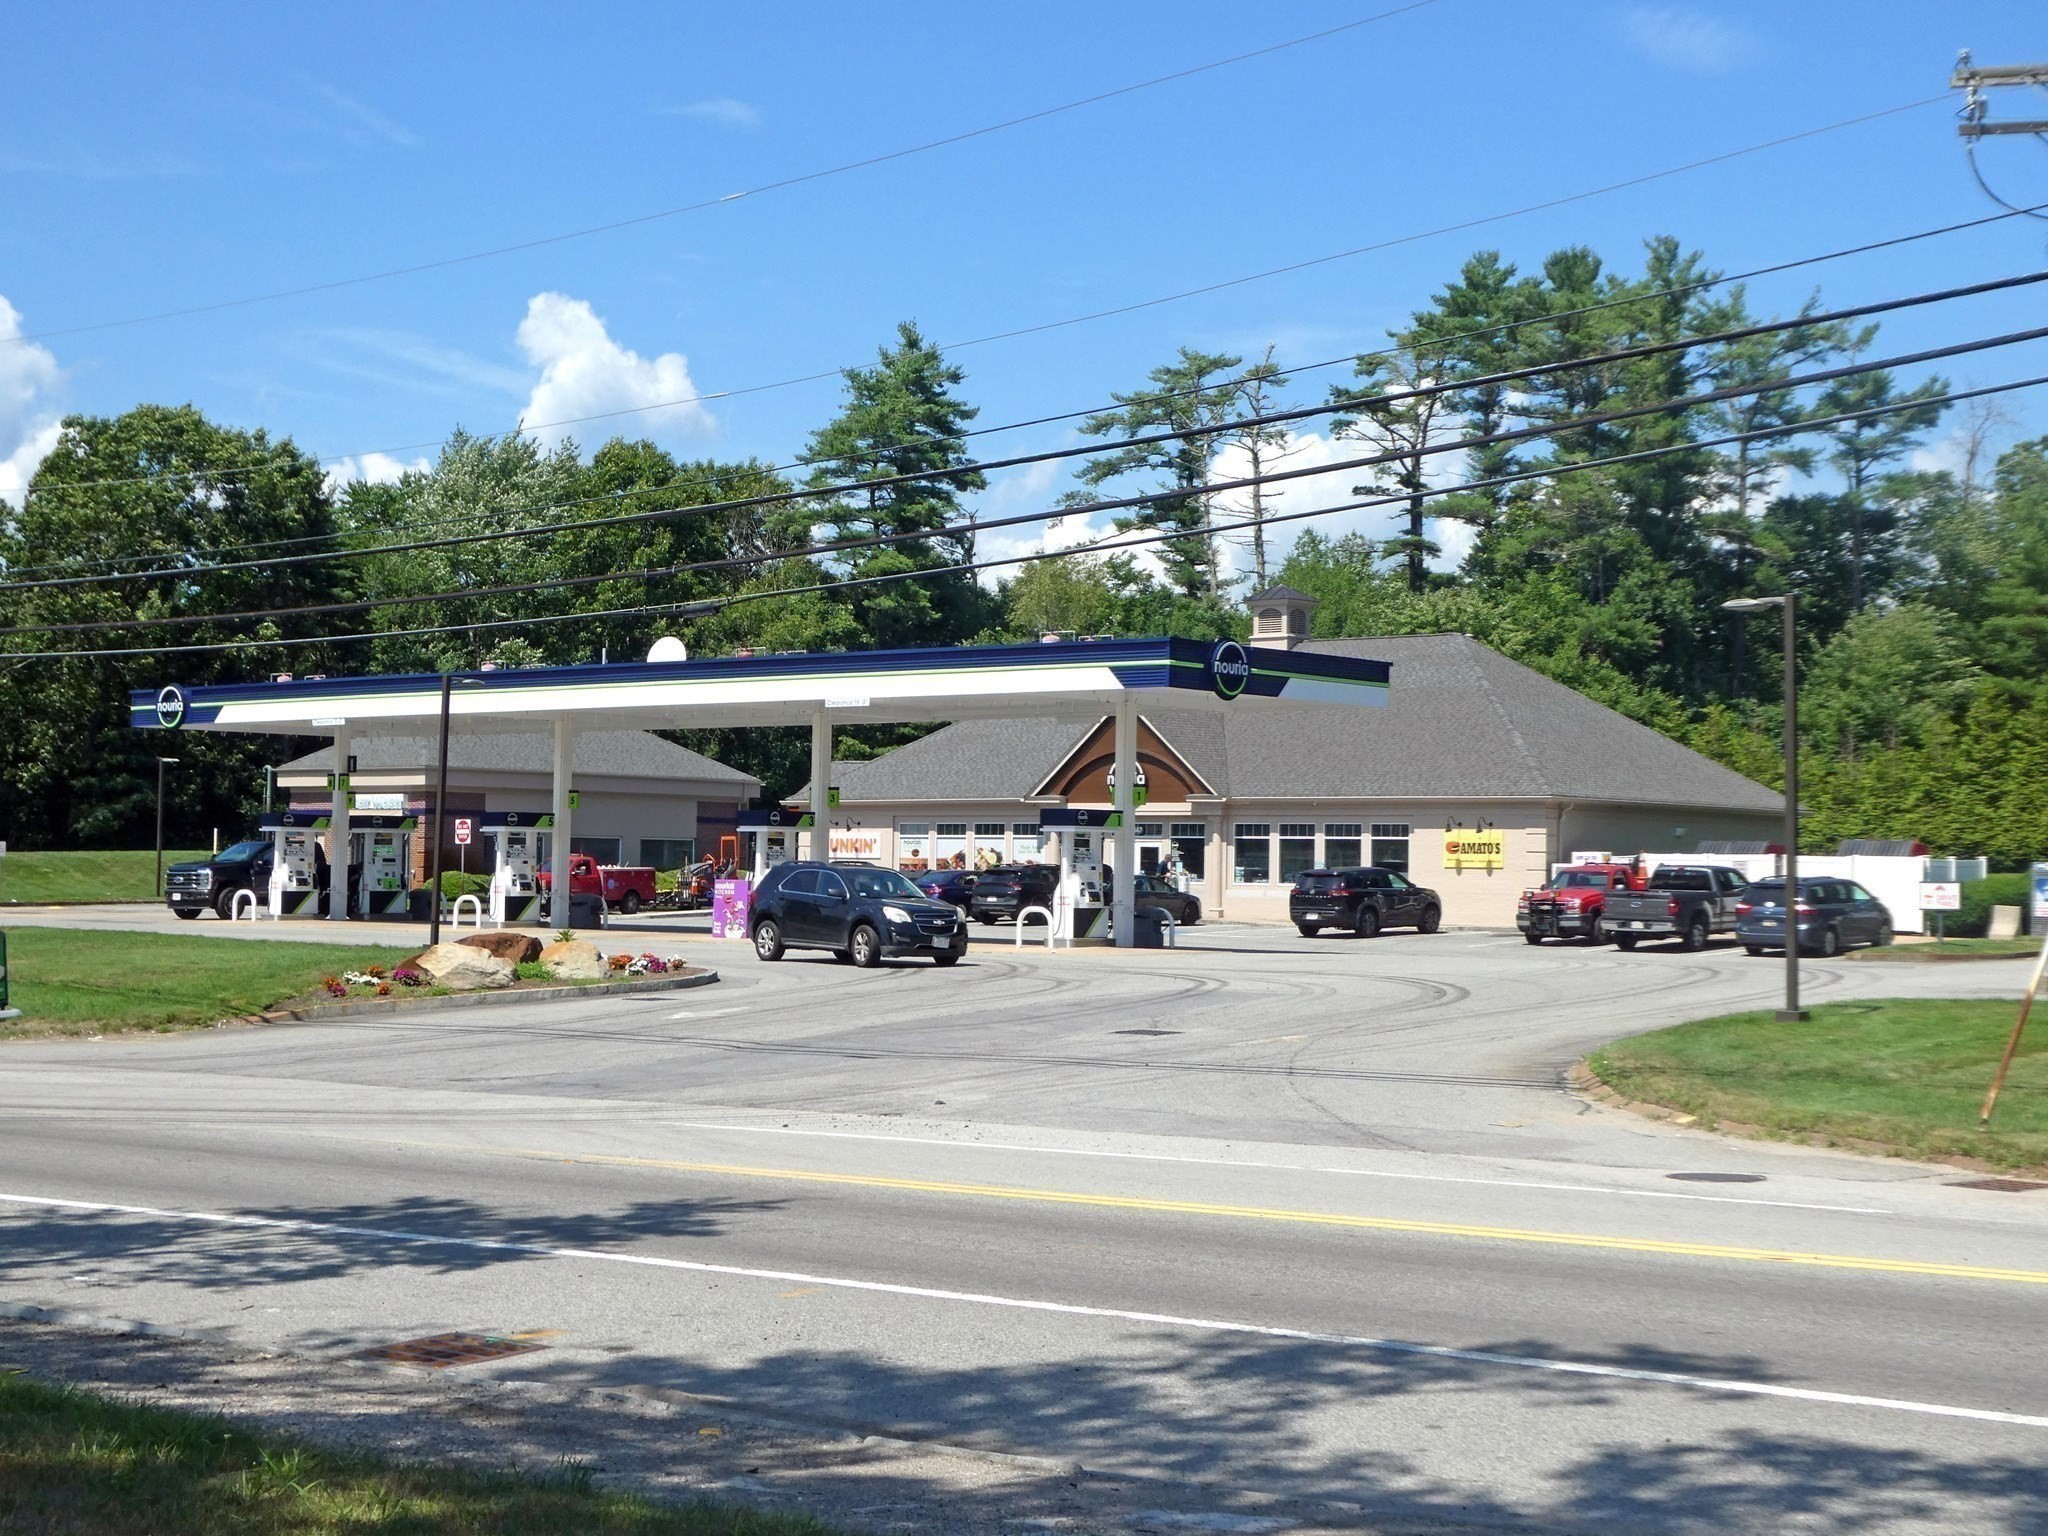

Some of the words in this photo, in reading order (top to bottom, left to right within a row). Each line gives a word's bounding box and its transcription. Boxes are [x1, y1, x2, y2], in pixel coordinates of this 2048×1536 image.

[1214, 660, 1248, 675] nouria
[157, 699, 183, 712] nouria
[570, 796, 575, 805] 5
[830, 794, 835, 803] 3
[325, 818, 332, 828] 7
[548, 817, 553, 826] 5
[808, 816, 814, 827] 3
[830, 838, 877, 853] UNKIN'
